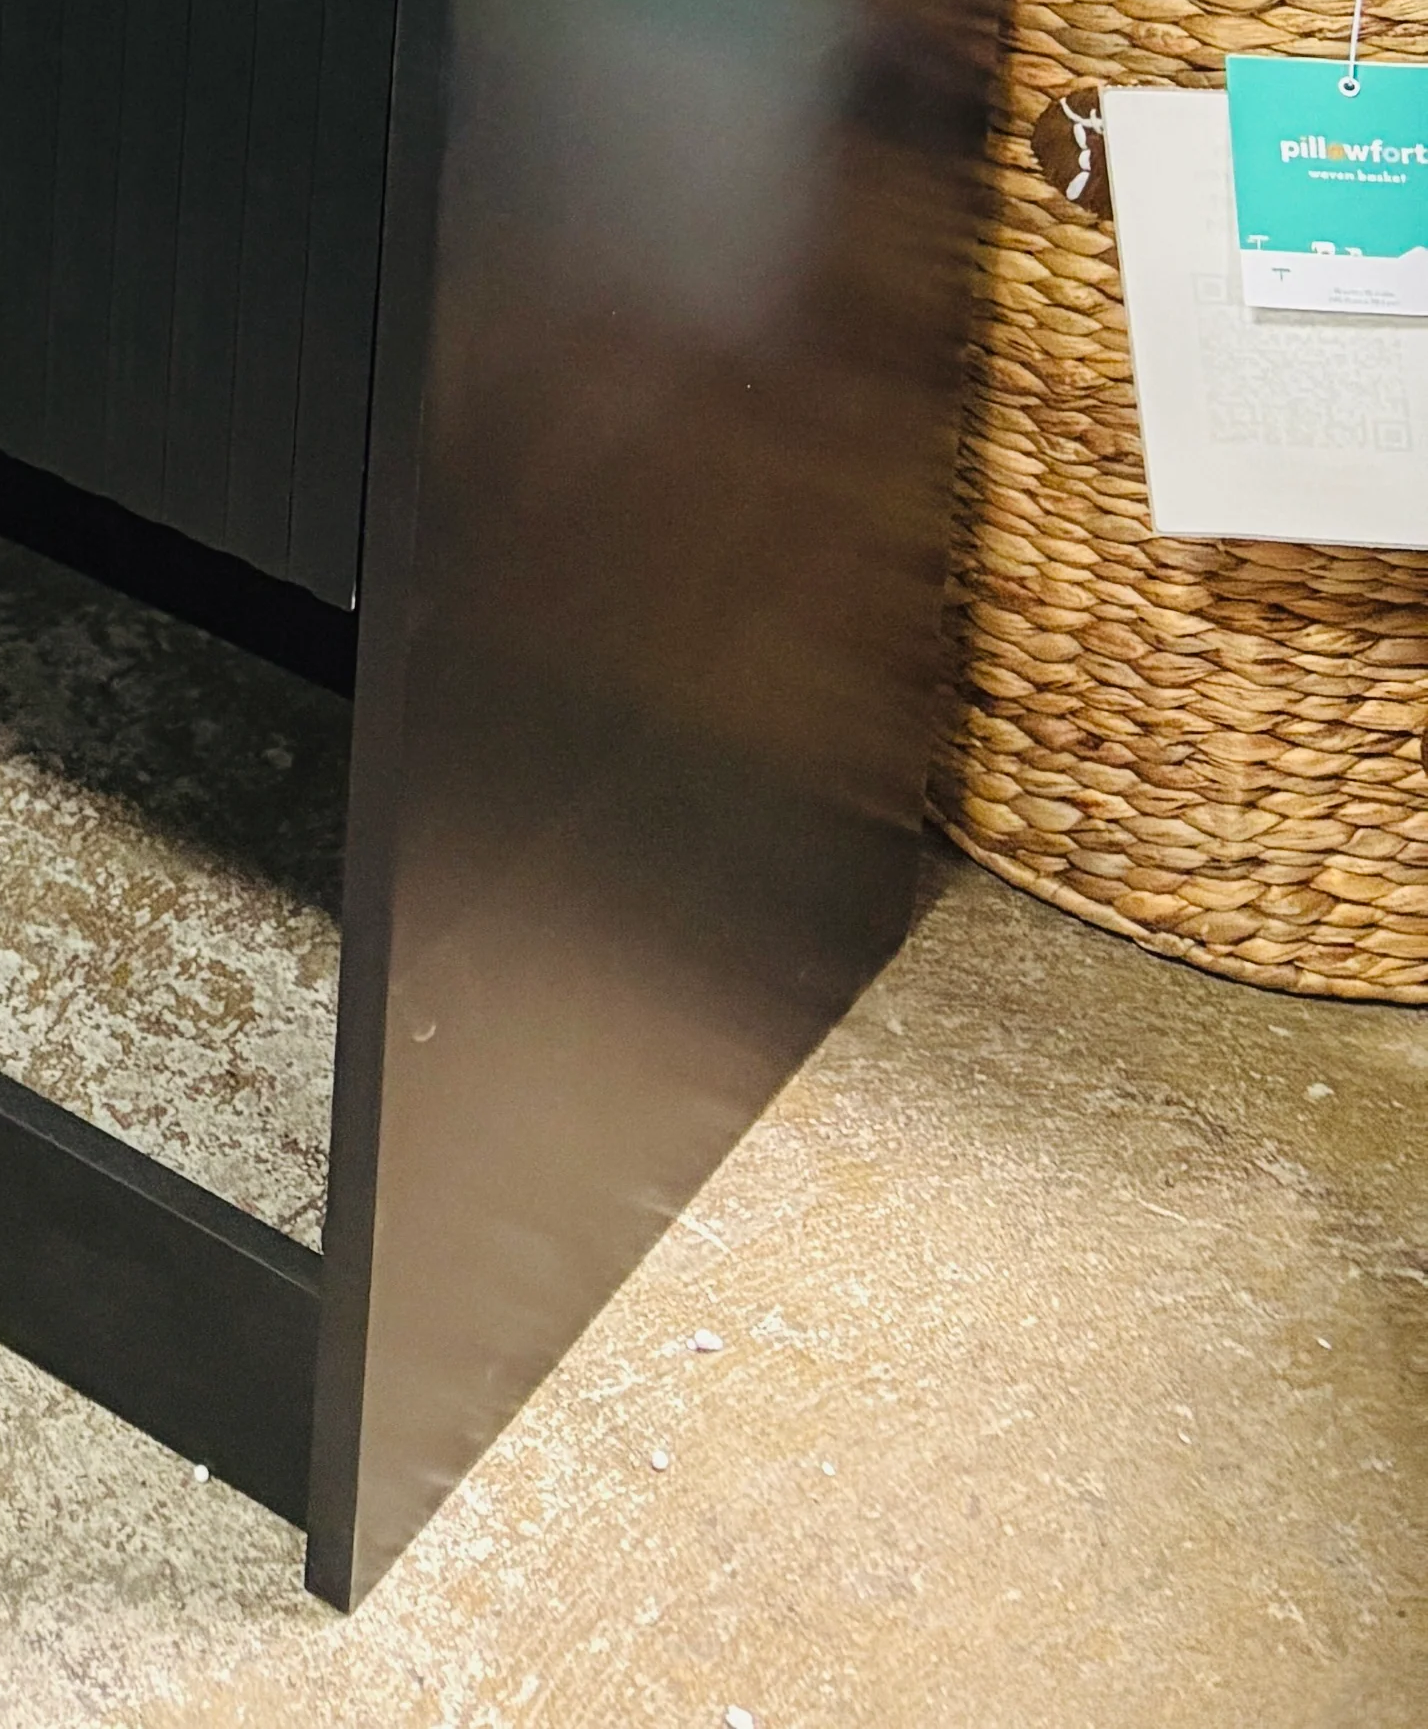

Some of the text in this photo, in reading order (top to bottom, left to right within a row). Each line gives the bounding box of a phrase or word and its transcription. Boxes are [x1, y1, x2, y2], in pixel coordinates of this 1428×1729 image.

[1279, 134, 1428, 165] pillowfort
[1307, 169, 1407, 184] woven basket
